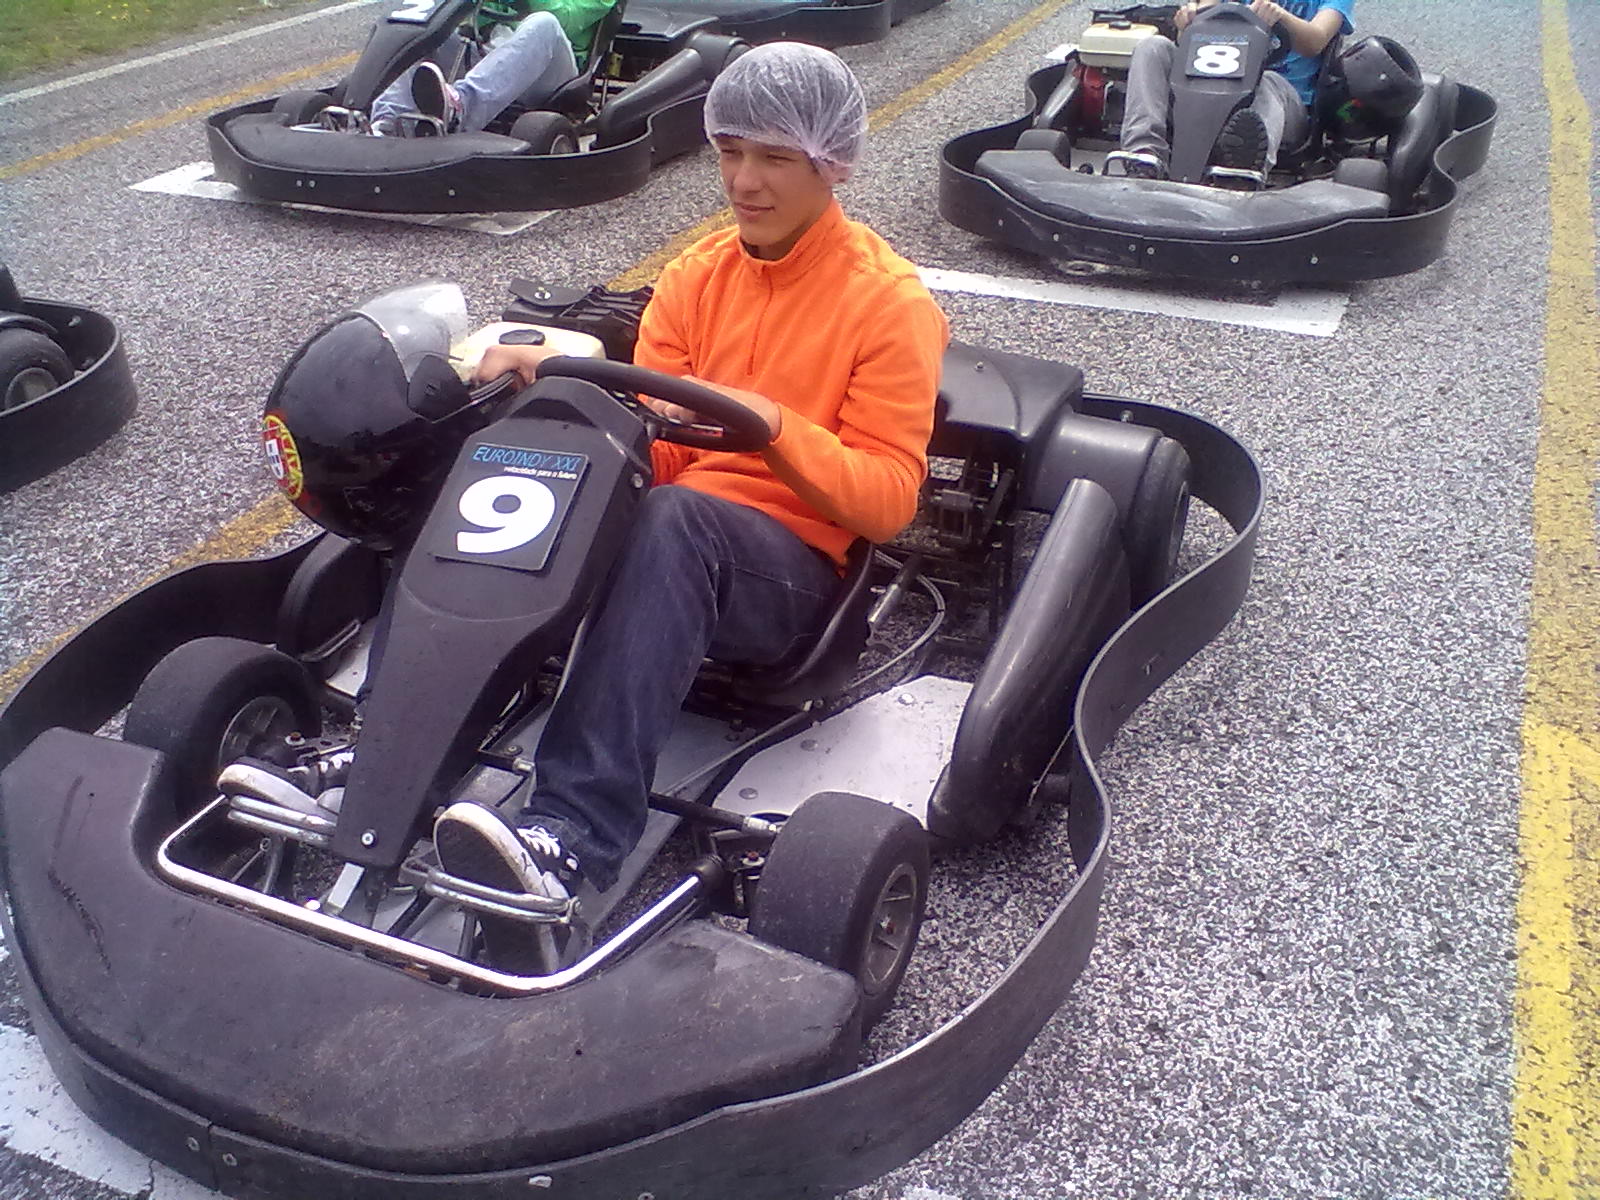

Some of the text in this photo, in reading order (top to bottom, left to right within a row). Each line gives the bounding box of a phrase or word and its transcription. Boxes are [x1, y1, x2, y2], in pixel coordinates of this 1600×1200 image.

[391, 0, 435, 19] 2
[1193, 45, 1240, 74] 8
[472, 446, 551, 467] EUROINDY
[457, 476, 556, 553] 9
